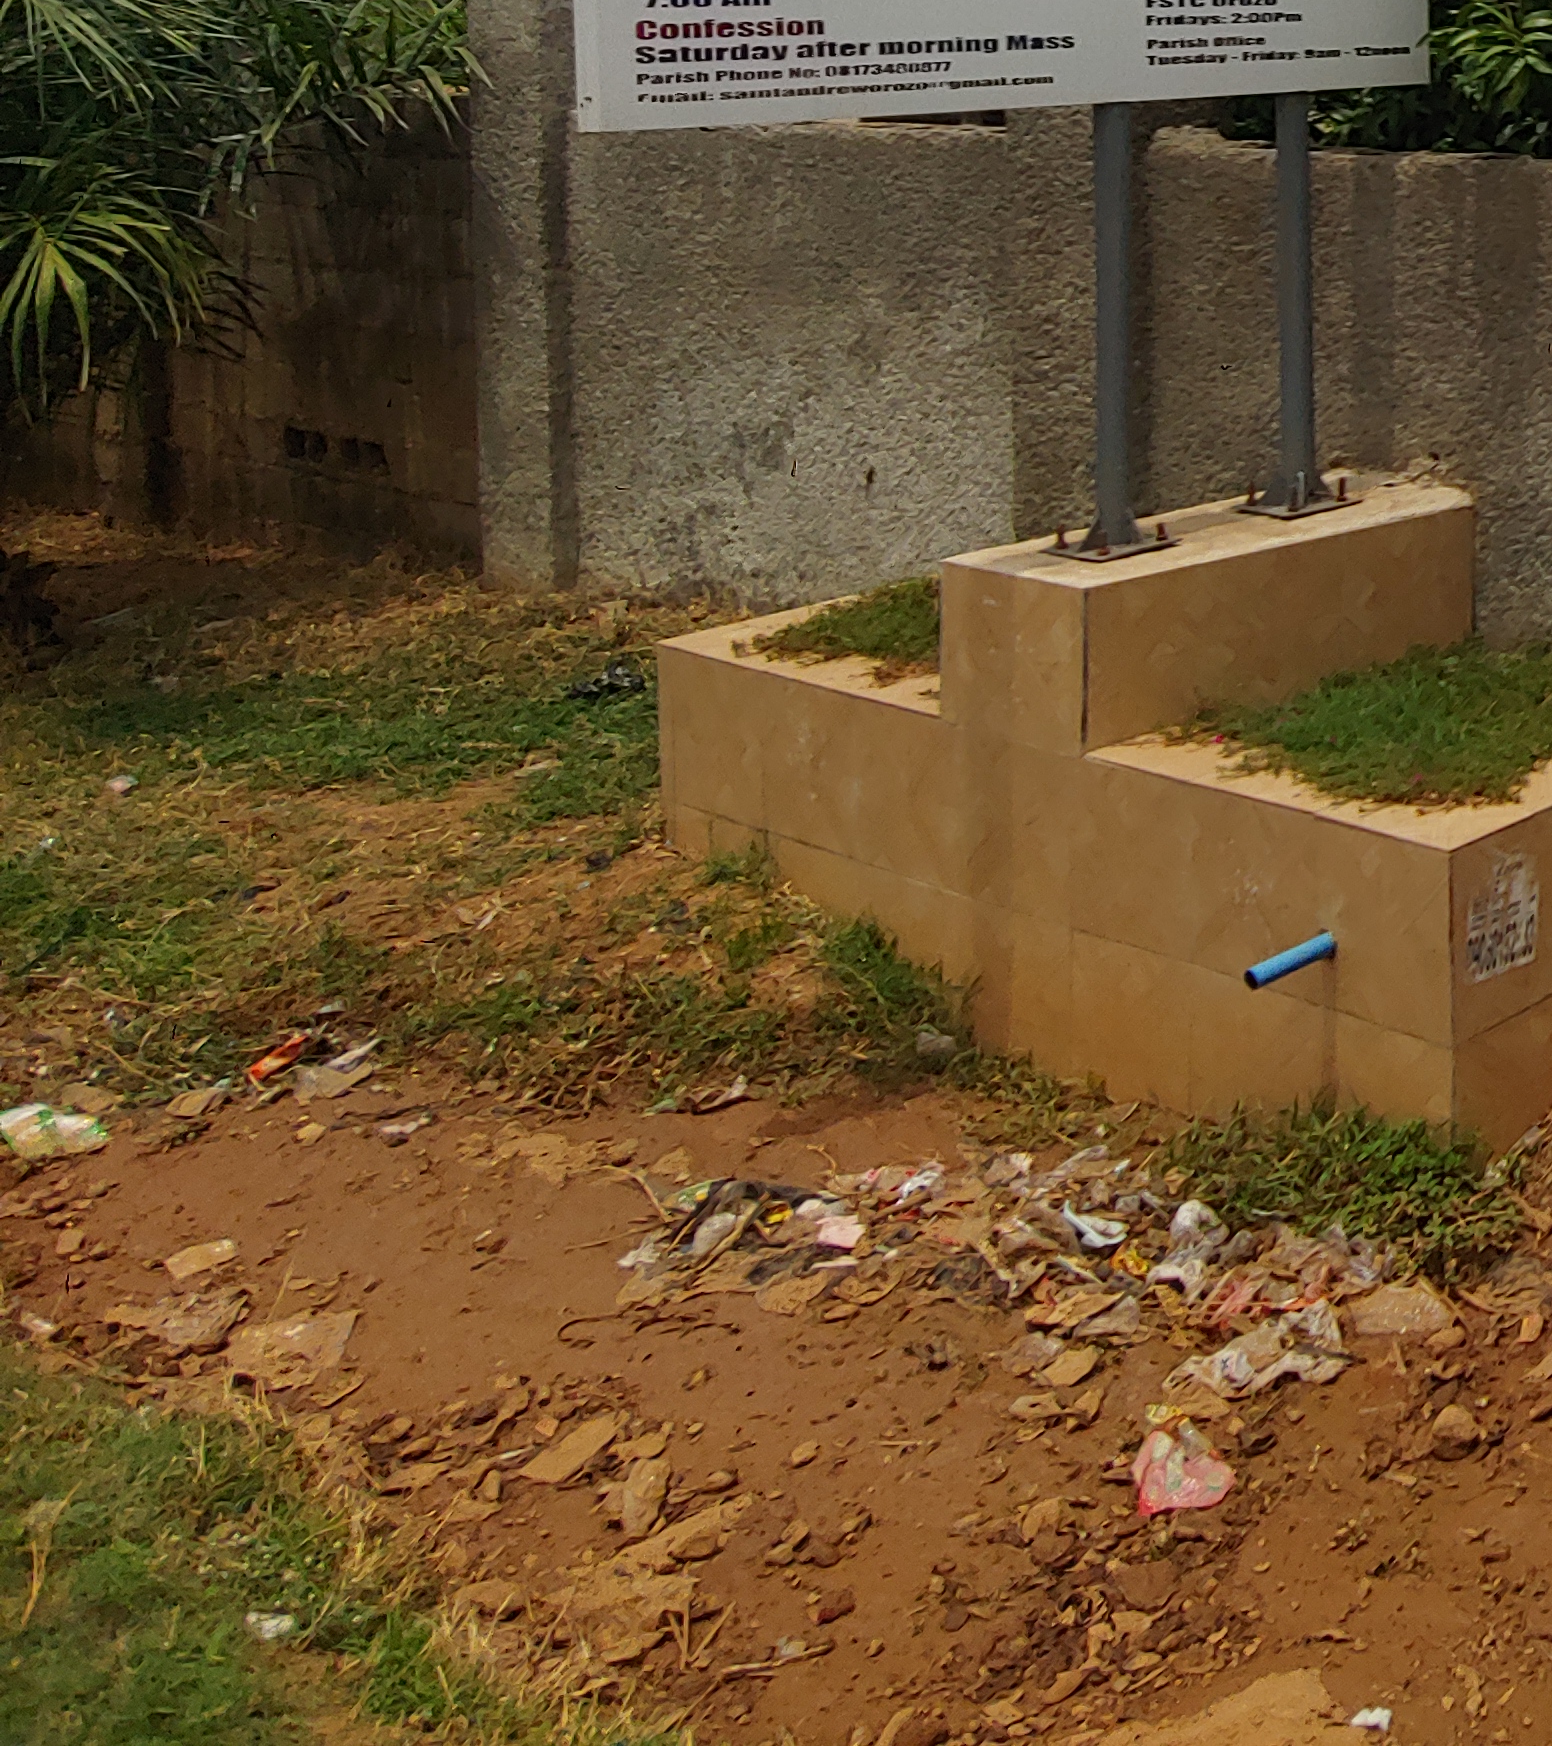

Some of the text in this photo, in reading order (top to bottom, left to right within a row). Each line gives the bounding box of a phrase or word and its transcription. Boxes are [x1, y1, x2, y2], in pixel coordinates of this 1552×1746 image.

[1146, 13, 1227, 26] Fridays:
[635, 17, 826, 41] Confession
[635, 35, 1076, 65] Saturday after morning Mass
[1146, 37, 1209, 50] Parish
[1147, 53, 1228, 66] Tuesday
[636, 70, 710, 85] Parish
[715, 68, 784, 83] Phone
[788, 66, 822, 79] No:
